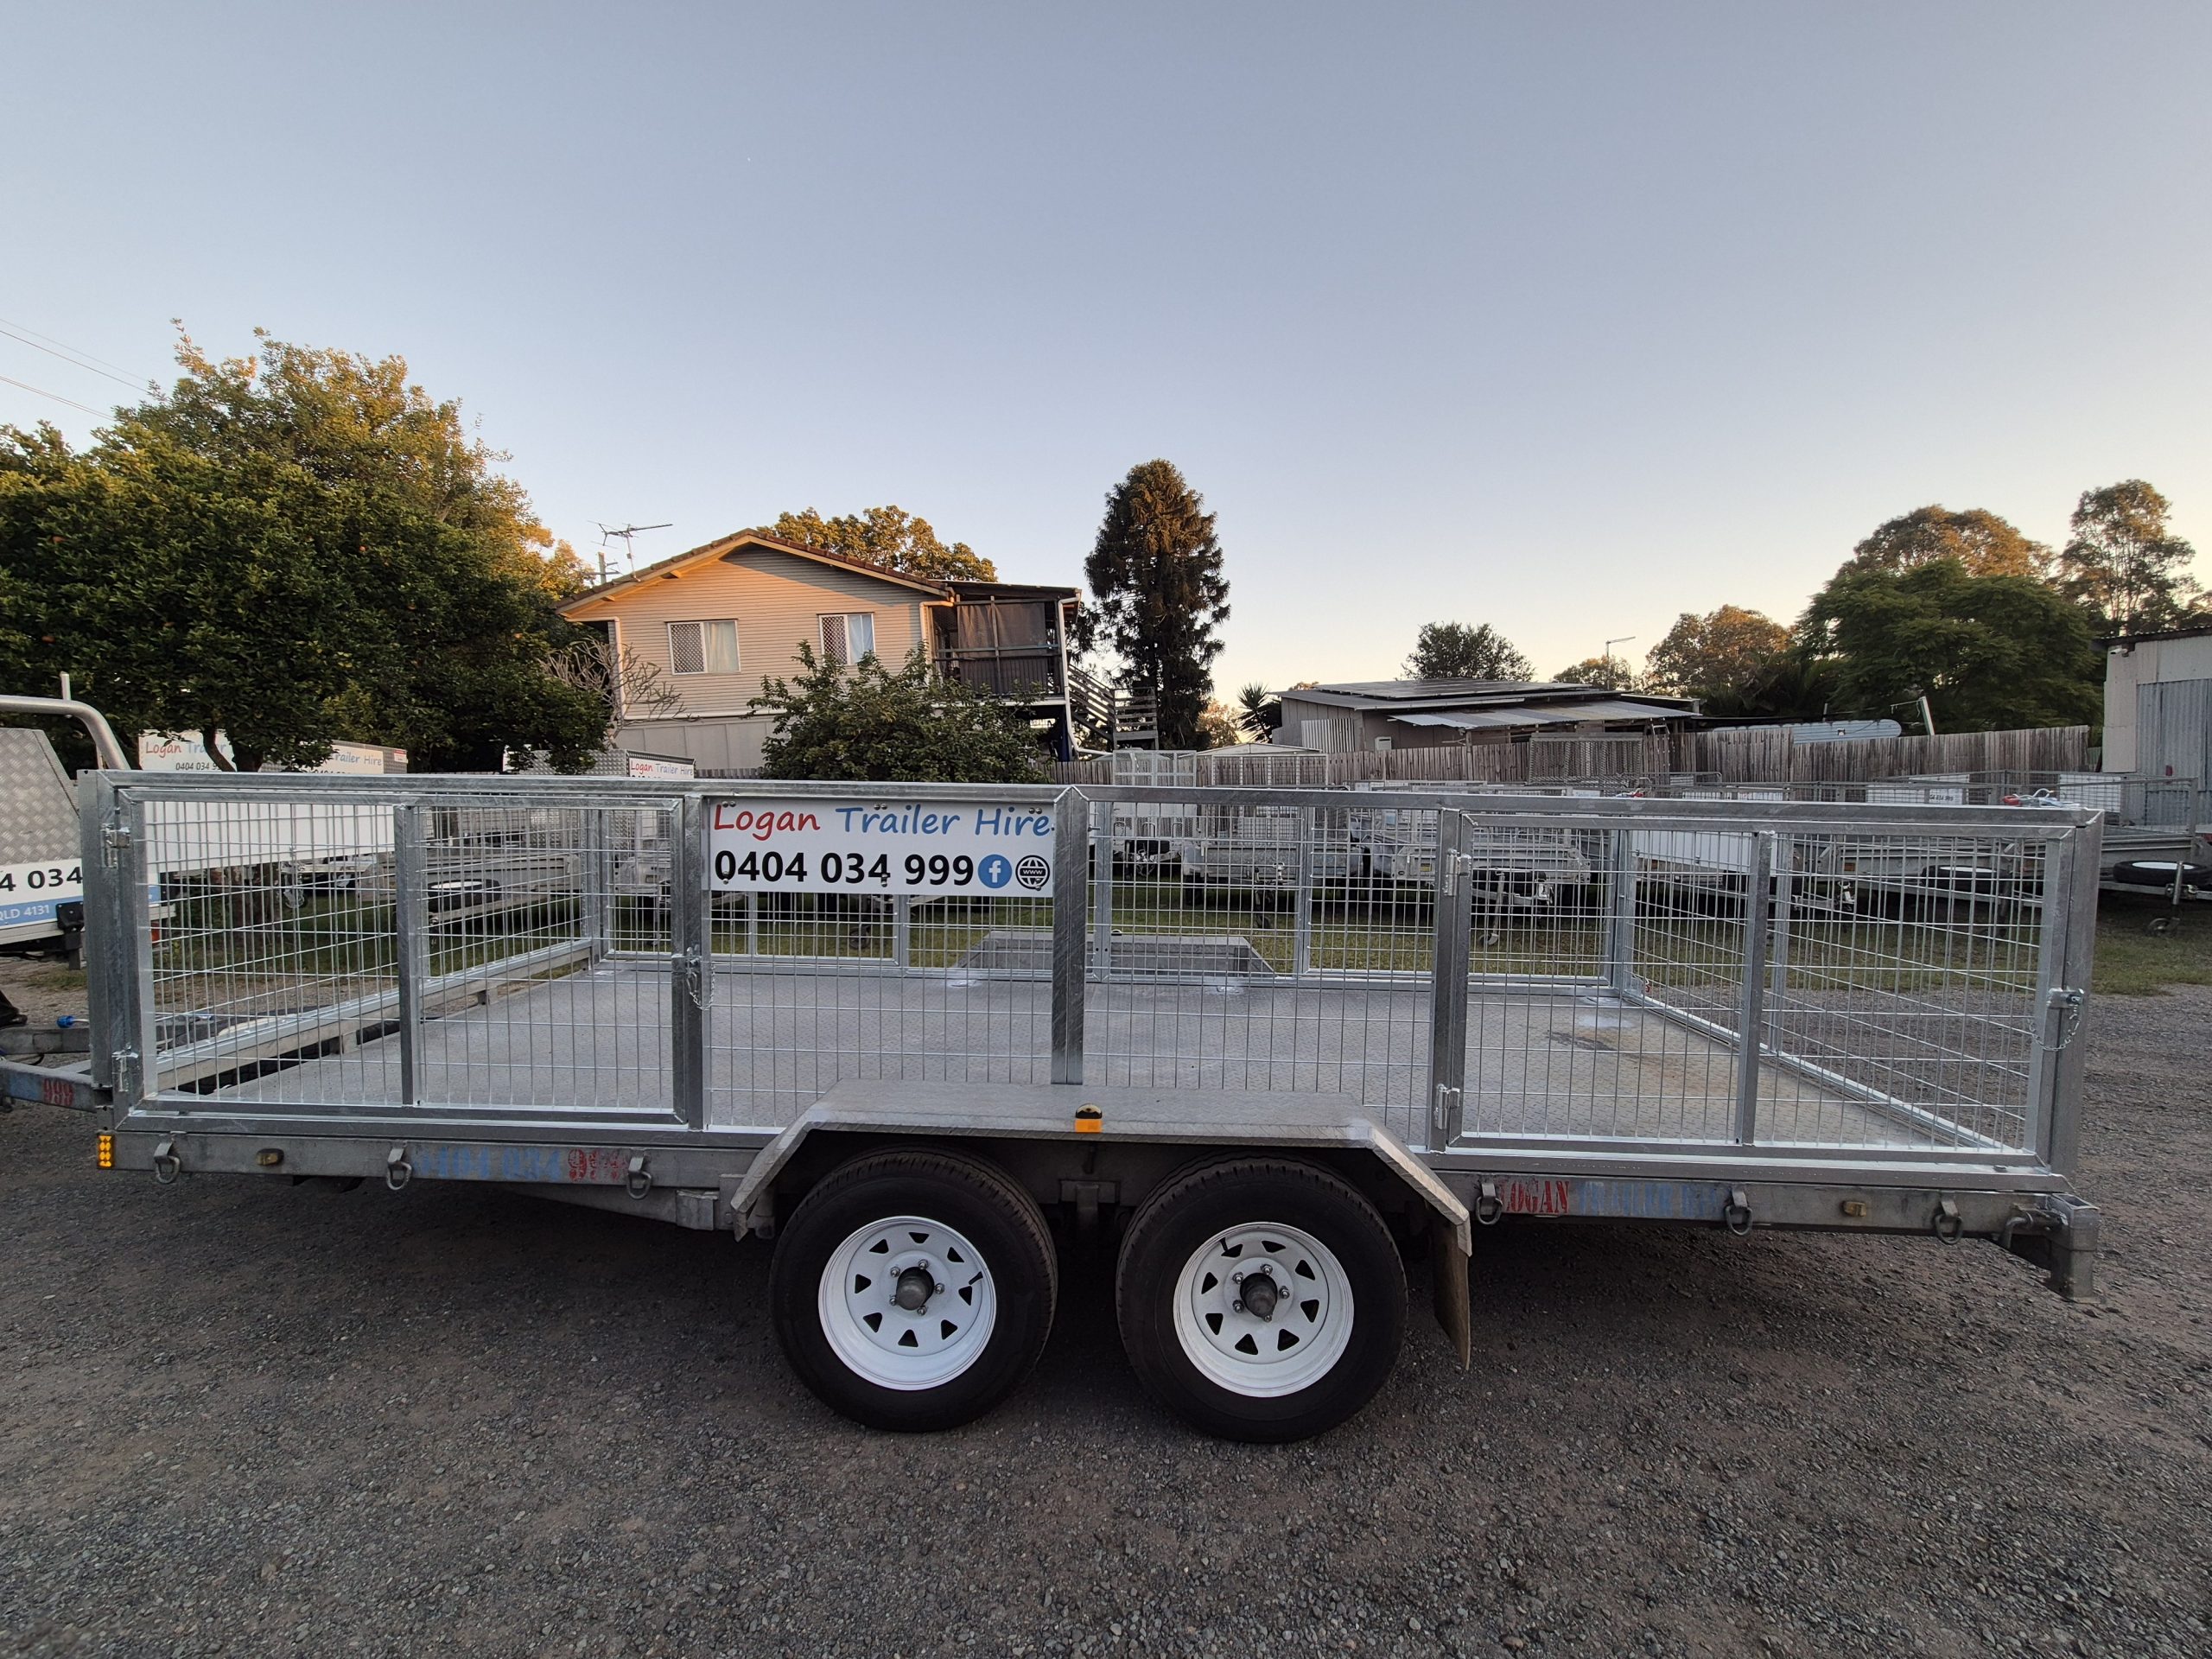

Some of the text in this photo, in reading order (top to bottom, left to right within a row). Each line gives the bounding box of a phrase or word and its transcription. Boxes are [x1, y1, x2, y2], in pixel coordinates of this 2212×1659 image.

[145, 741, 226, 758] Logan Trar
[175, 762, 194, 771] 0404
[196, 762, 209, 771] 034
[334, 751, 360, 764] railer
[364, 754, 383, 766] Hire
[631, 760, 693, 776] Logan Trailer Hire
[714, 804, 1051, 841] Logan Trailer Hire
[715, 850, 974, 886] 0404 034 999
[28, 866, 83, 890] 034
[23, 904, 49, 916] 4131
